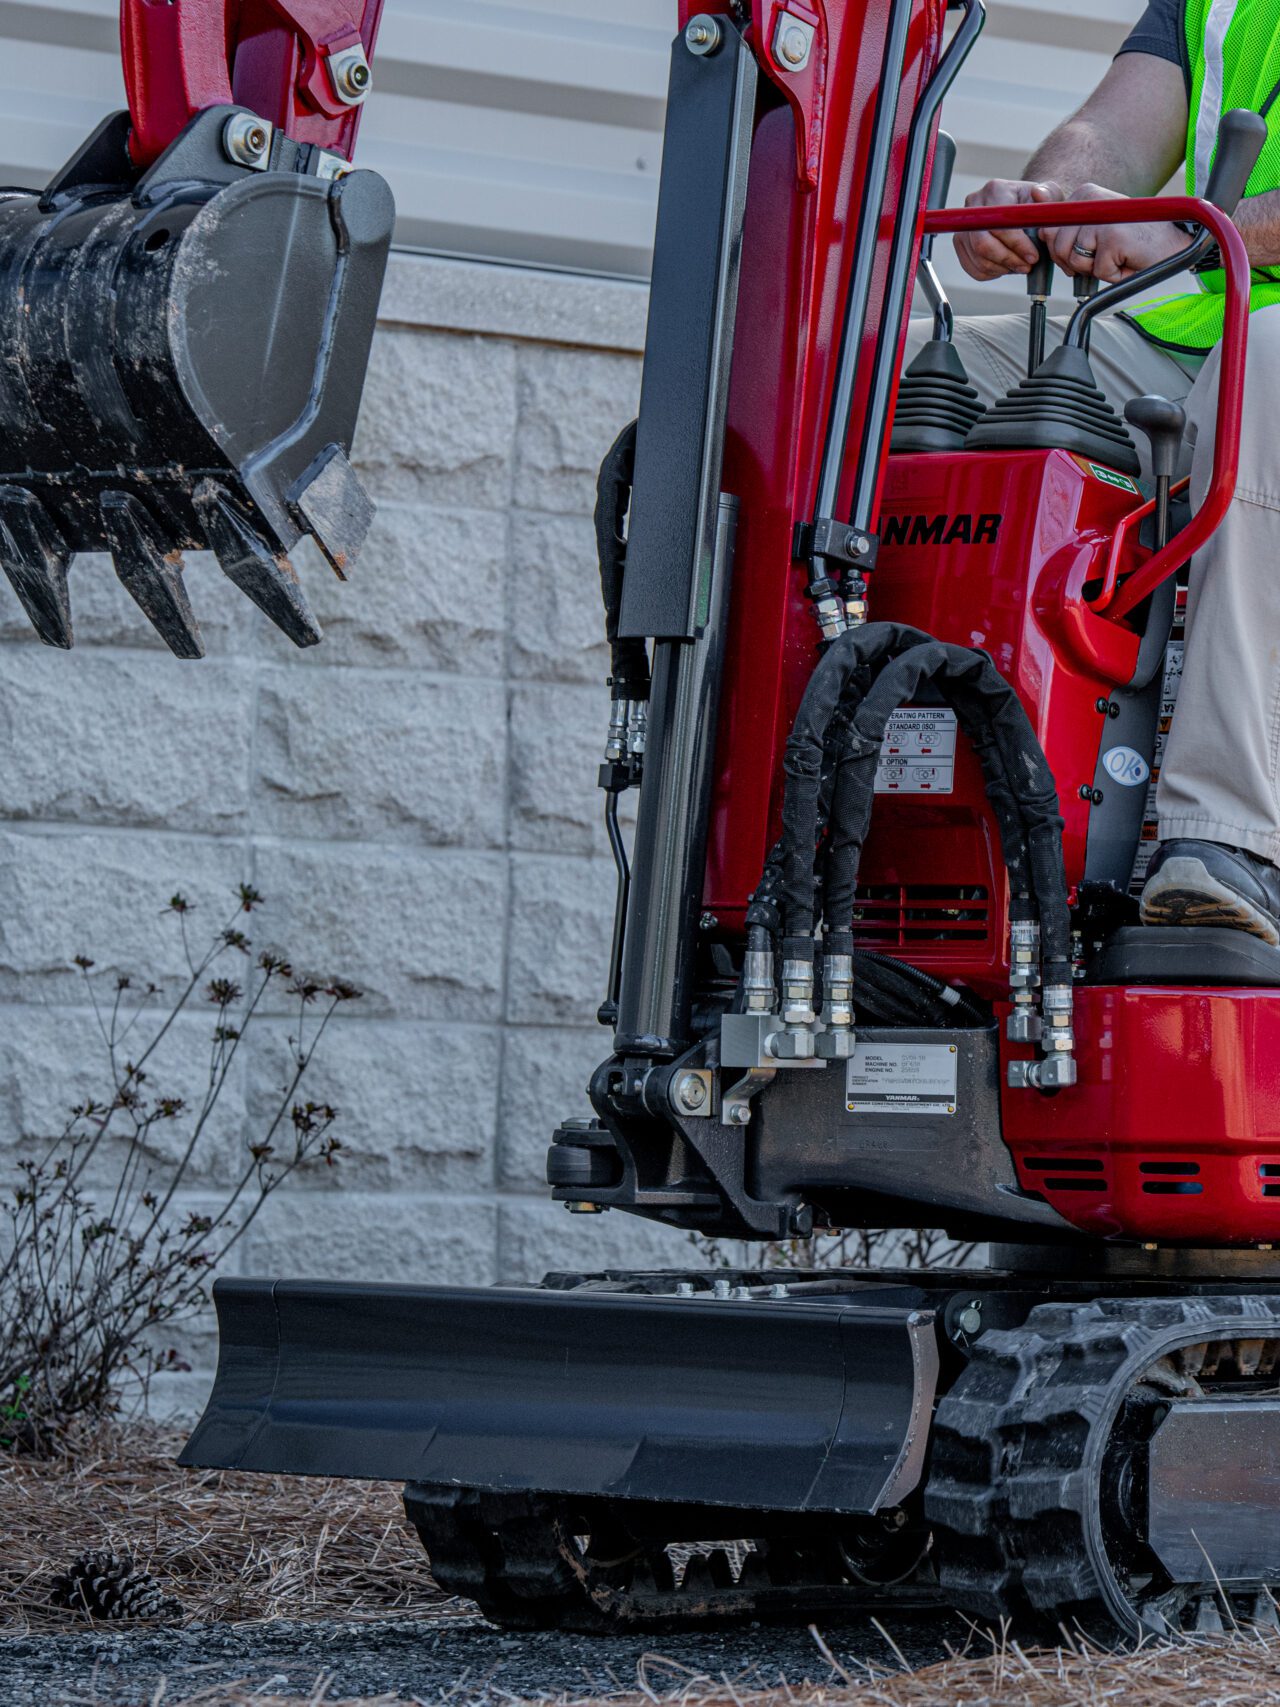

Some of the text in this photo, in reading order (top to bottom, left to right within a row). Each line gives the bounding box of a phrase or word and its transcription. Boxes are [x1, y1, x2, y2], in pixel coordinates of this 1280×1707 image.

[877, 514, 1003, 545] NMAR
[917, 712, 945, 720] PATTERN
[886, 758, 908, 766] OPTION
